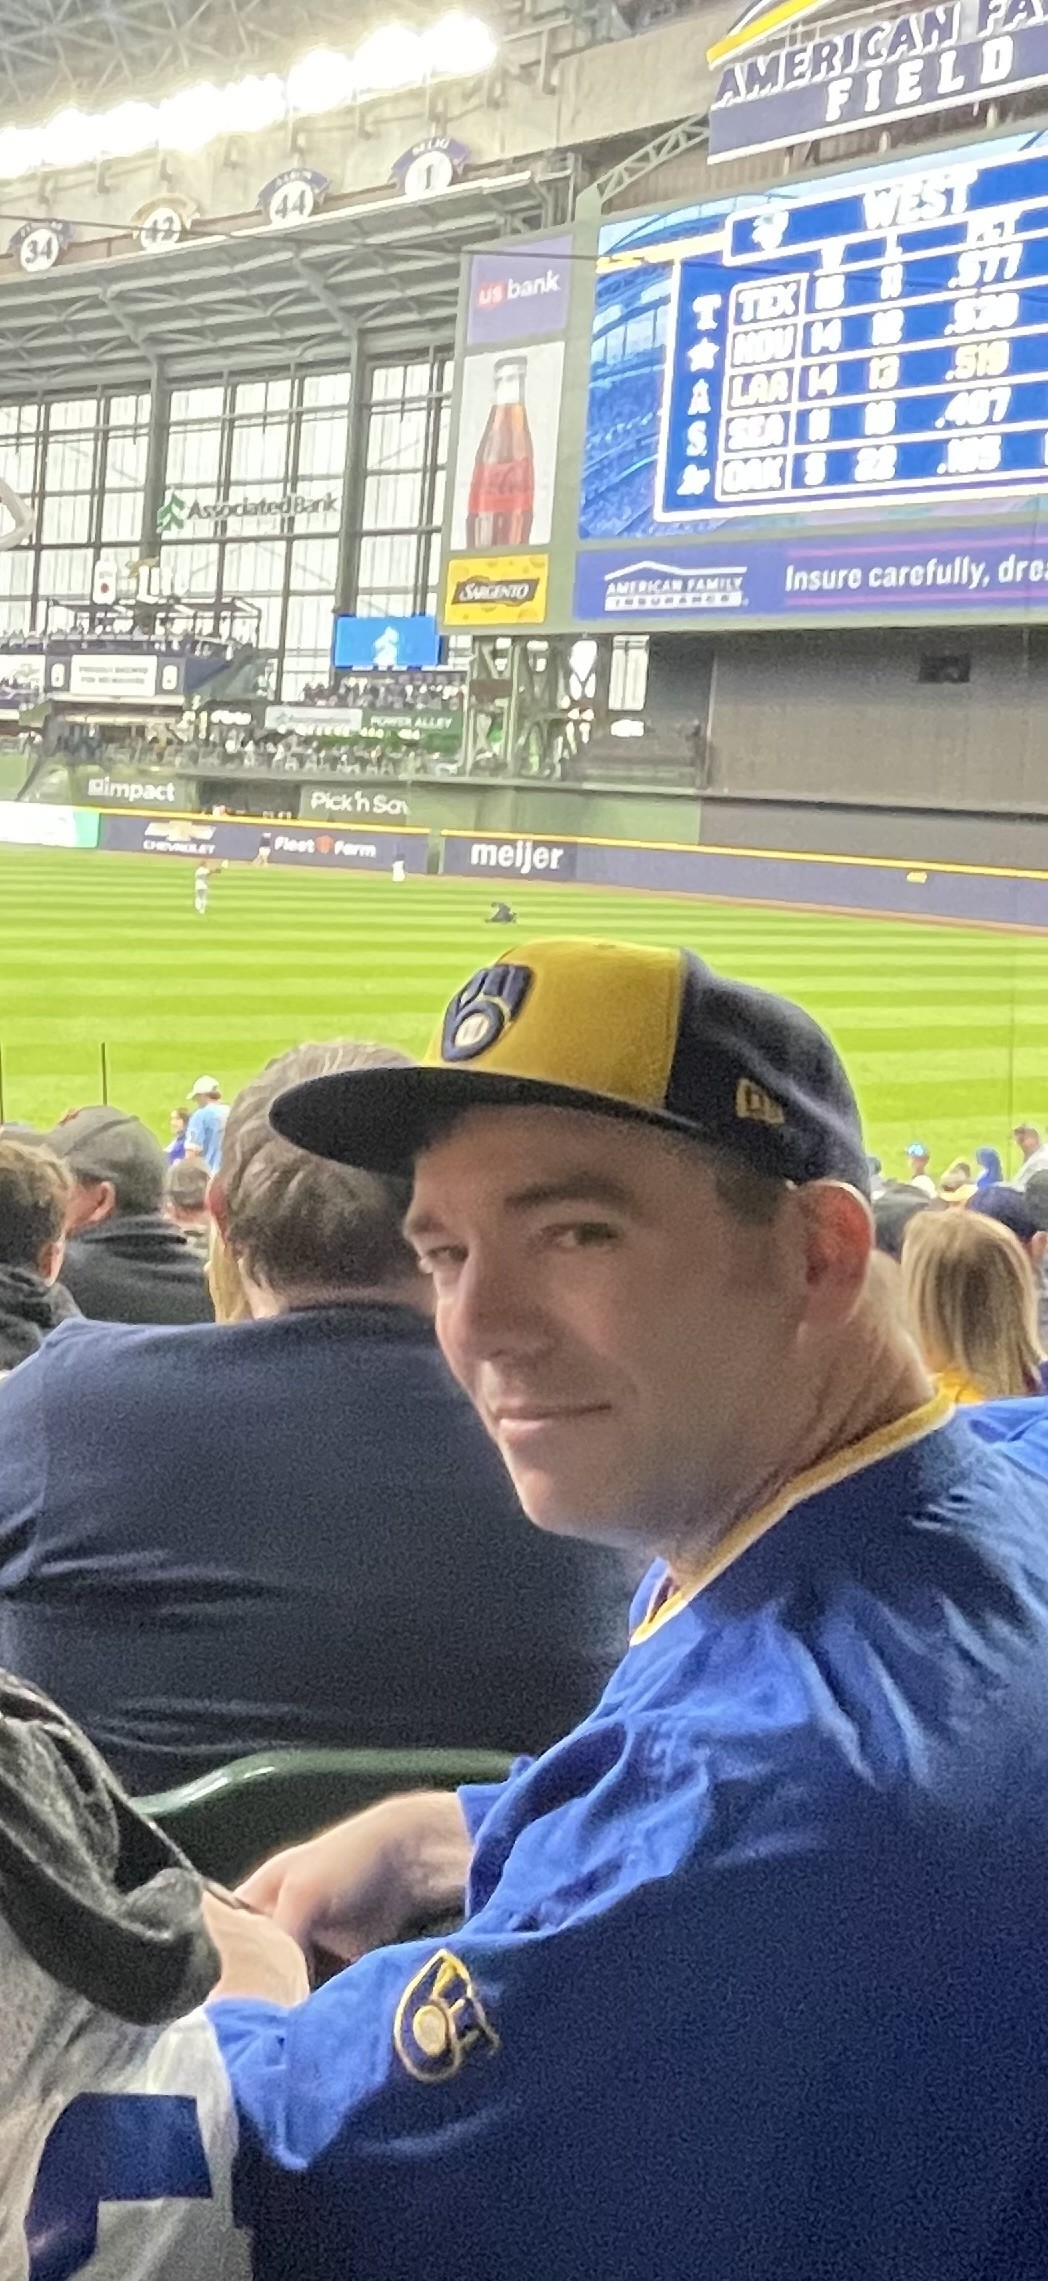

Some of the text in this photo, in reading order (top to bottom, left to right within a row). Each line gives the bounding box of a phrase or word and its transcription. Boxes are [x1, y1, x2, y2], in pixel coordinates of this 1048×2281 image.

[711, 0, 1048, 111] AMERICAN FA
[825, 35, 1014, 122] FIELD
[275, 189, 306, 219] 44
[863, 168, 979, 231] WEST
[145, 215, 176, 243] 42
[25, 236, 53, 264] 34
[479, 269, 561, 306] us bank
[738, 282, 798, 322] TEX
[811, 317, 842, 354] 14
[729, 370, 789, 408] LAA
[808, 362, 838, 398] 14
[727, 413, 785, 450] SEA
[722, 455, 784, 493] OAK
[187, 491, 338, 520] Associated Bank
[605, 576, 743, 597] AMERICAN FAMILY
[784, 564, 862, 592] Insure
[868, 555, 990, 590] carefully,
[459, 582, 530, 602] SARGENTO
[414, 716, 453, 729] ALLEY
[104, 775, 176, 803] impact
[310, 790, 352, 812] Pick
[142, 839, 216, 855] CHEVROLET
[274, 835, 377, 858] Fleet Farm
[470, 839, 564, 875] meijer
